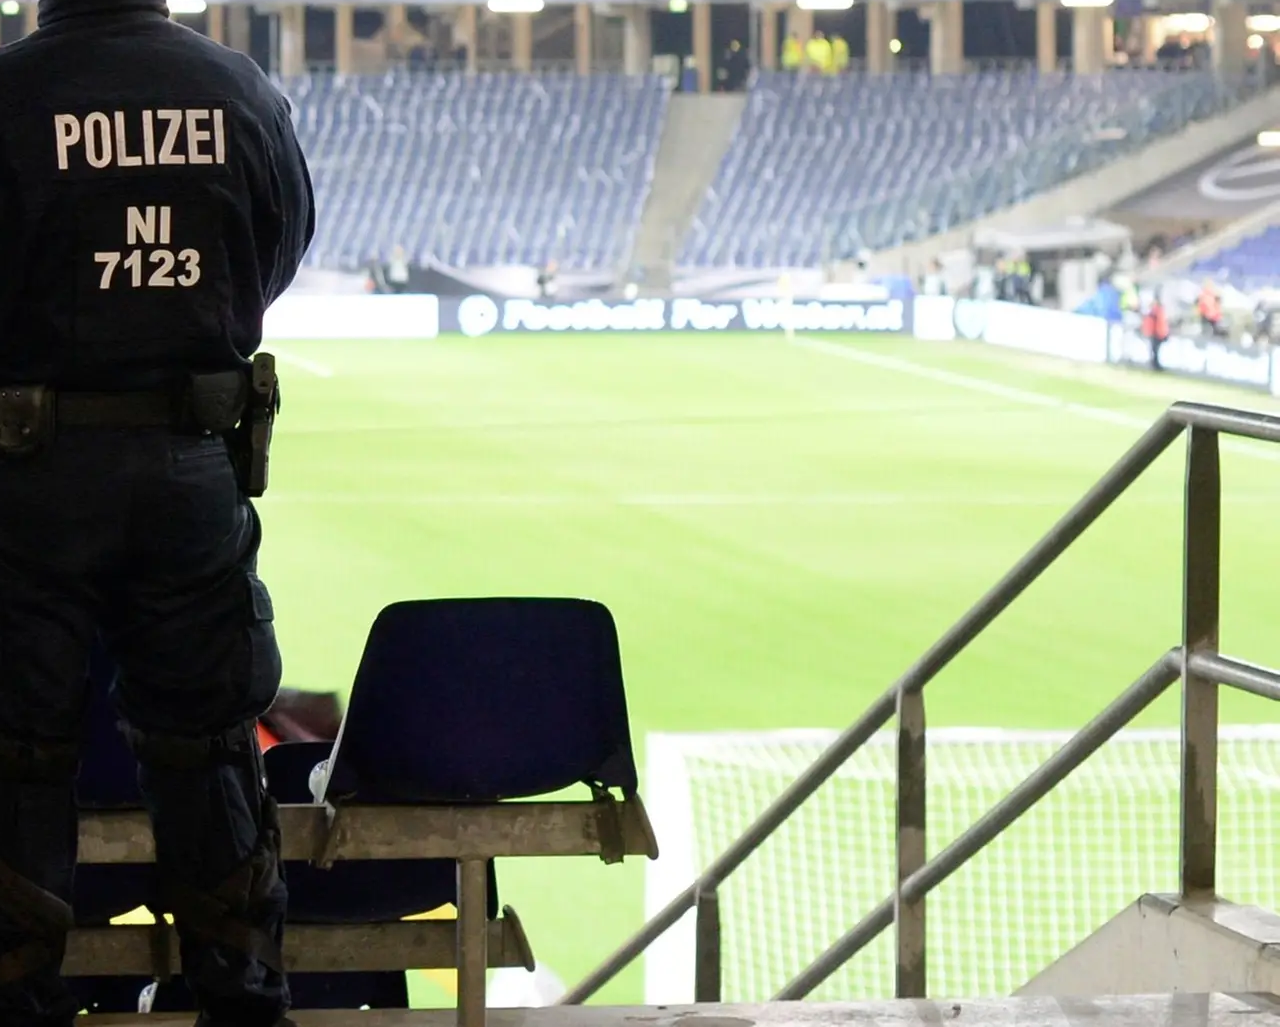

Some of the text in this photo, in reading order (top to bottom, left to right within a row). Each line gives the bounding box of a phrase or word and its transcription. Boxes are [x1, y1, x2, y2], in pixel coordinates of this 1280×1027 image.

[54, 108, 226, 170] POLIZEI
[127, 206, 171, 245] NI
[94, 248, 201, 290] 7123
[502, 298, 666, 330] Football
[670, 298, 737, 330] For
